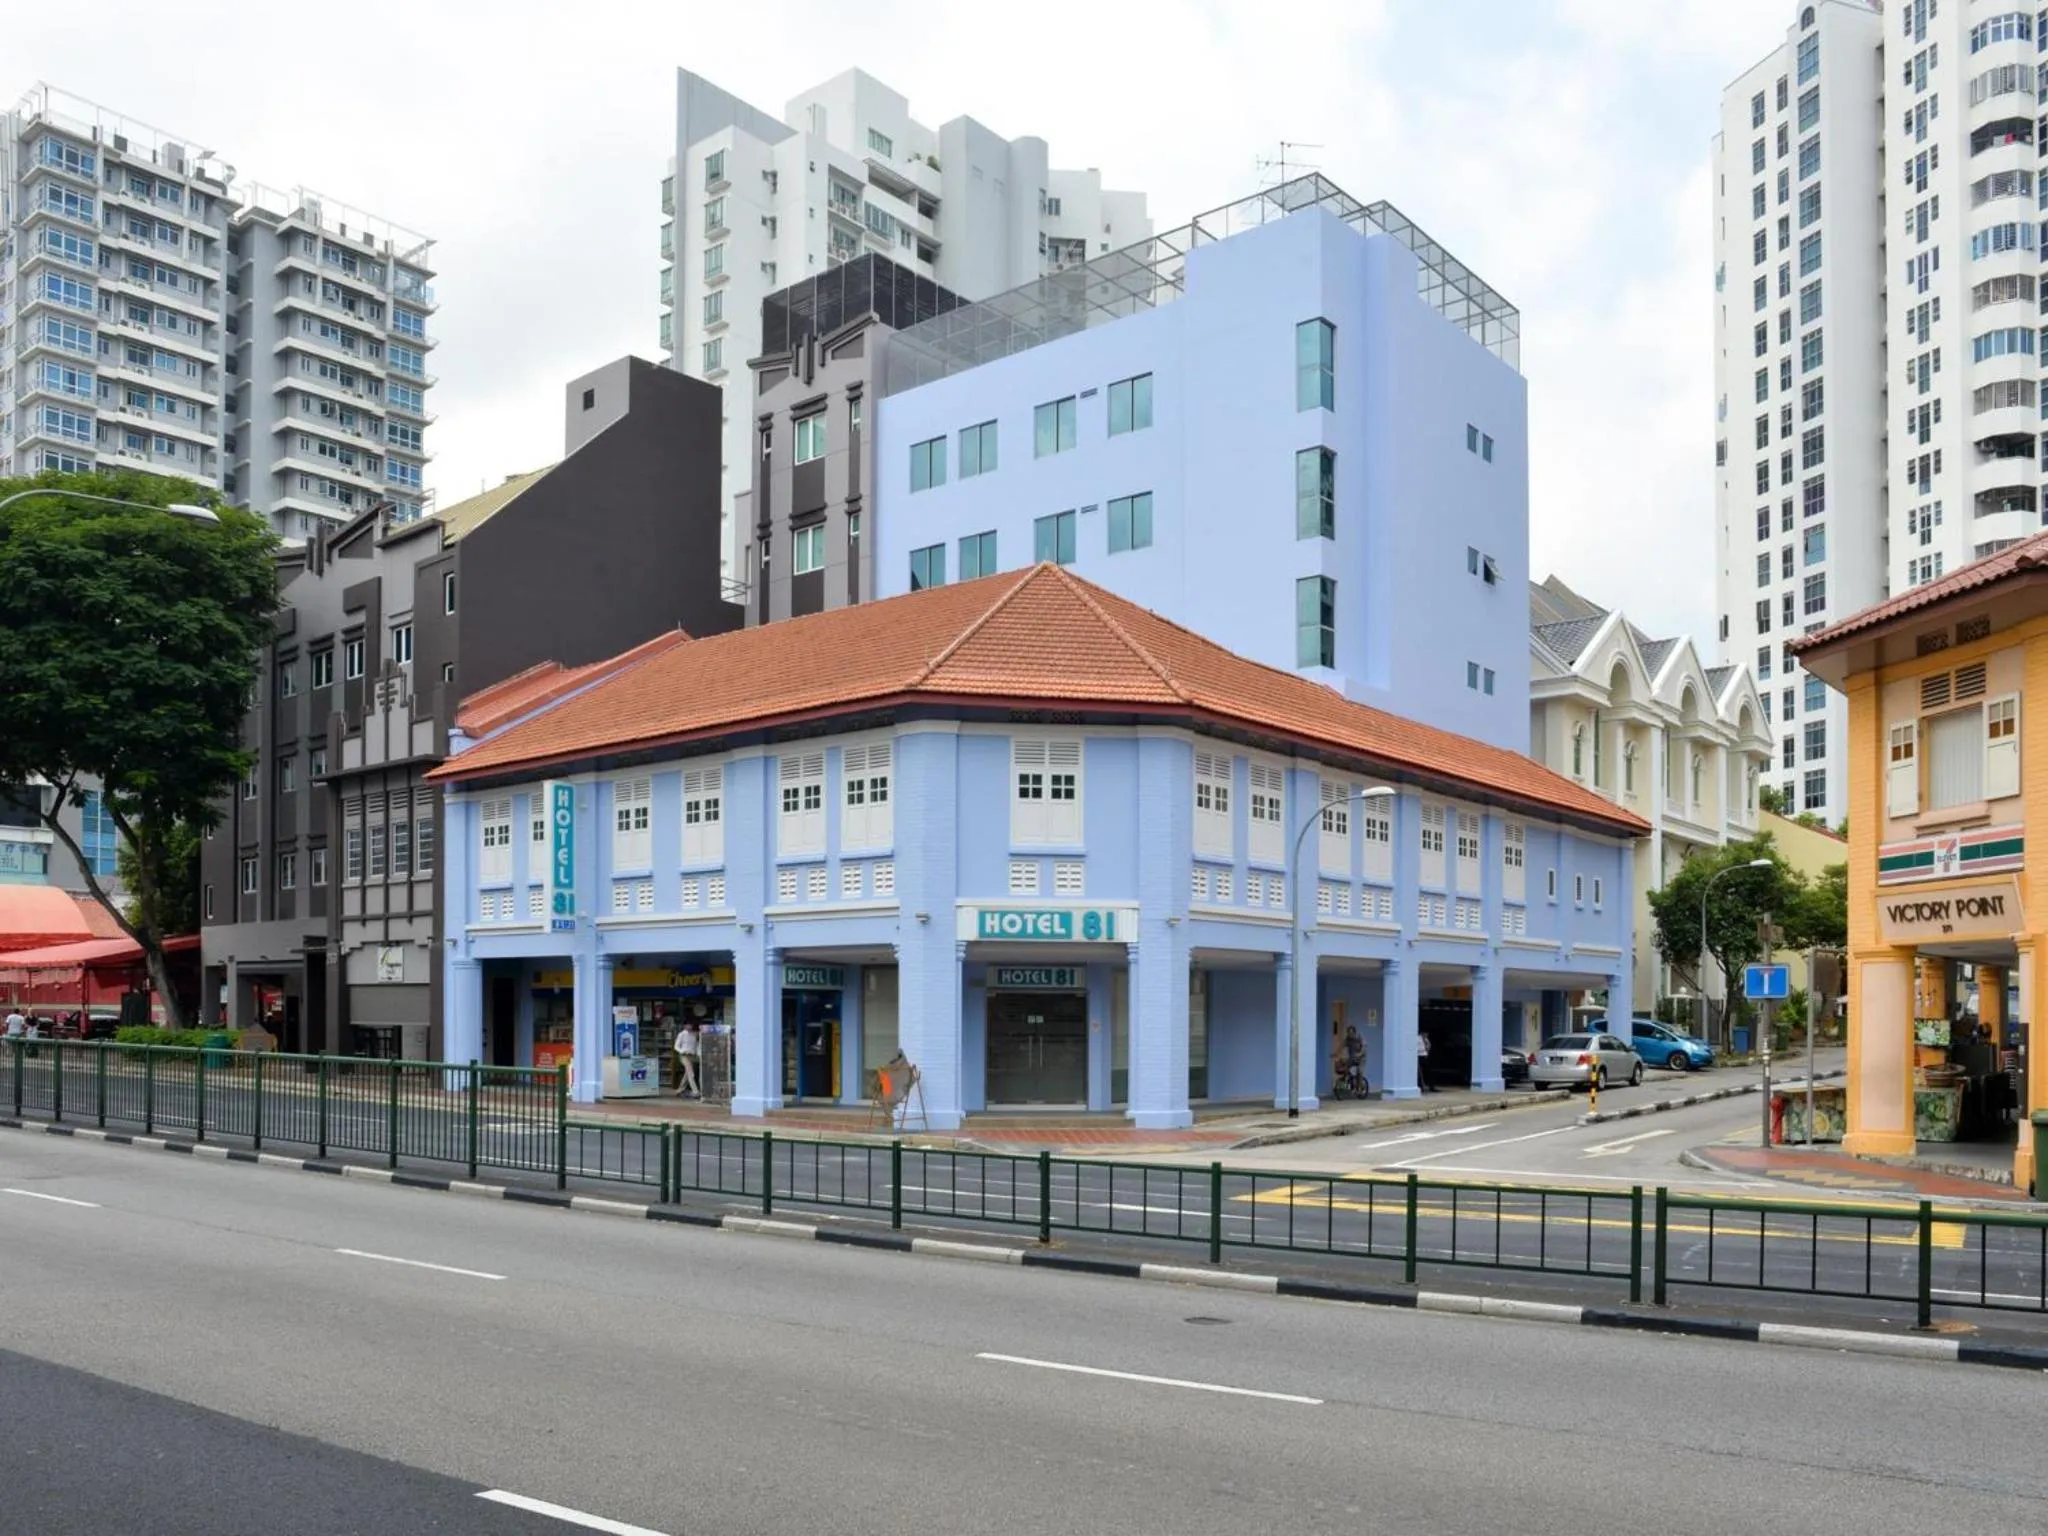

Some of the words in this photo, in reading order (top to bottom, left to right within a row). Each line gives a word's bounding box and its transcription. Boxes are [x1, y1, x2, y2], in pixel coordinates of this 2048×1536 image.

[555, 789, 570, 884] HOTEL
[552, 891, 575, 915] 81
[1887, 901, 1950, 923] VICTORY
[1955, 896, 2004, 919] POINT
[984, 912, 1066, 934] HOTEL
[1083, 911, 1114, 940] 81
[787, 969, 824, 984] HOTEL
[1002, 970, 1049, 984] HOTEL
[1057, 969, 1075, 985] 81
